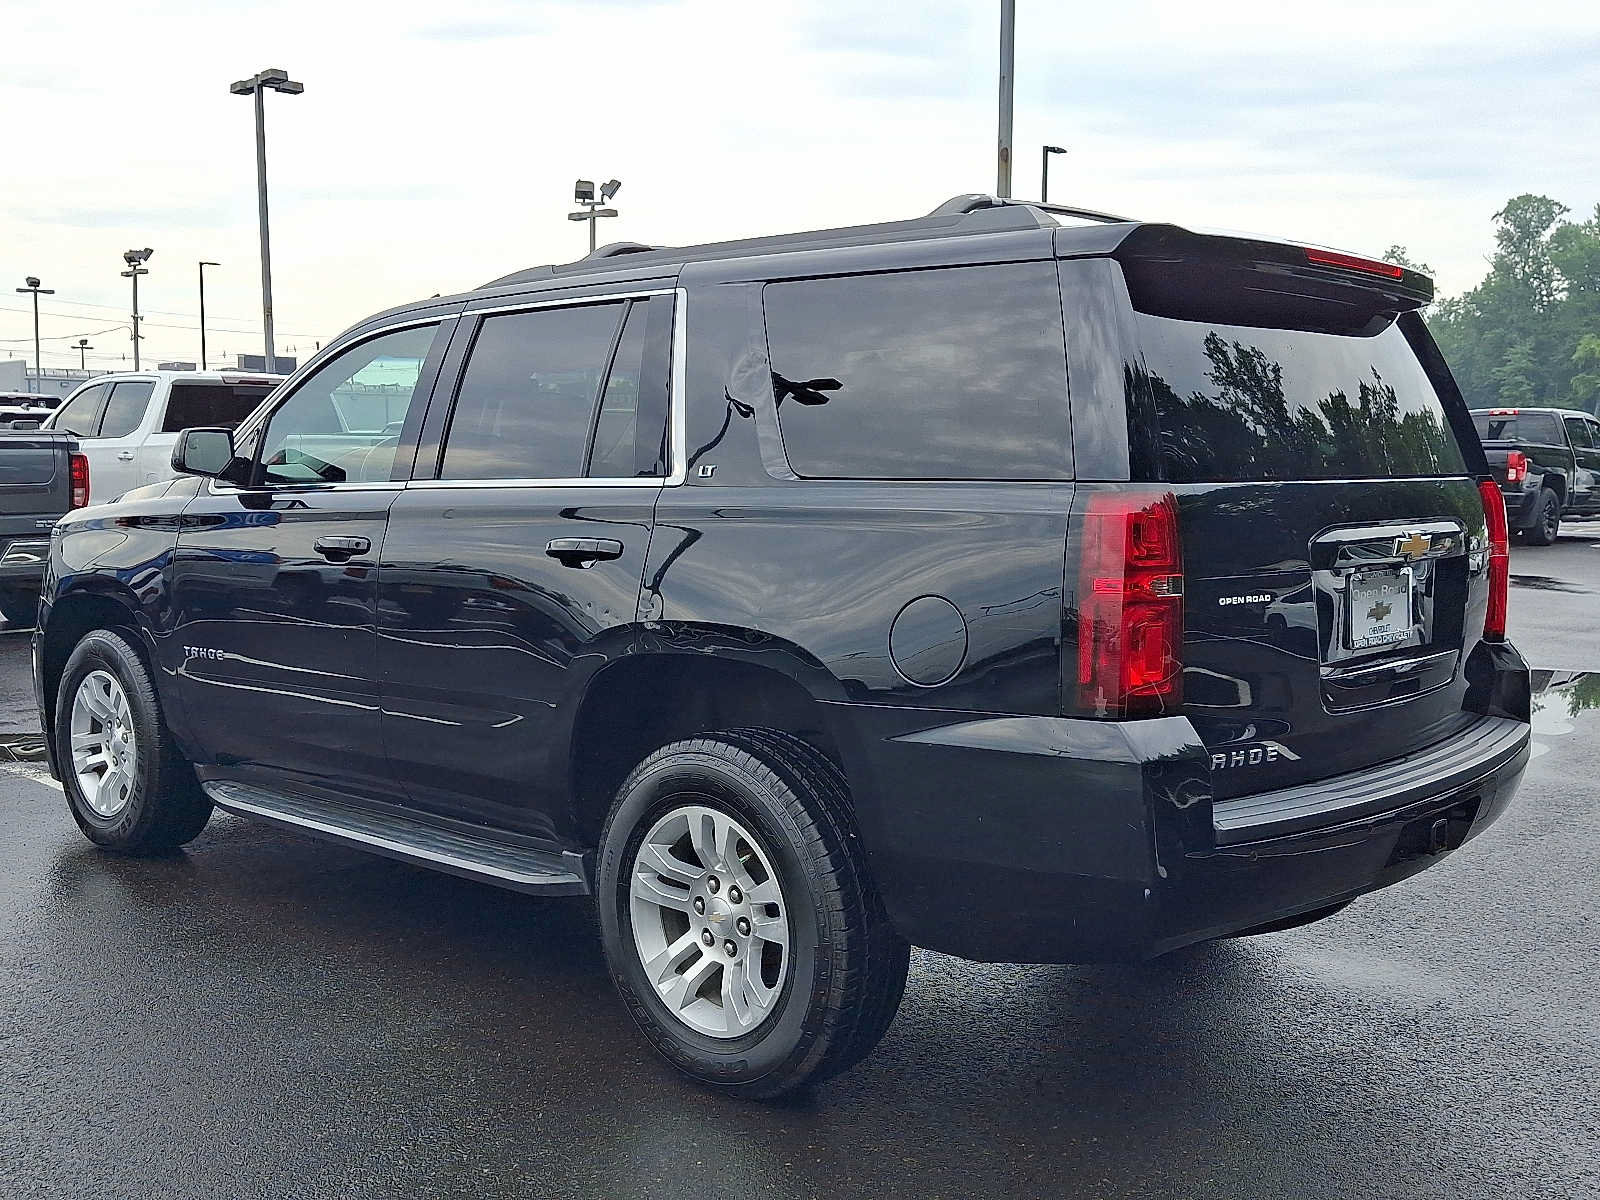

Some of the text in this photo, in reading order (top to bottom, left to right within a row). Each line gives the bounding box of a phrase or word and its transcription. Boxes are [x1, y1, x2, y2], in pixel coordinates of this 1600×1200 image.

[698, 465, 717, 477] LT
[1219, 595, 1271, 605] OPEN ROAD
[1352, 589, 1378, 601] Open
[183, 645, 224, 661] TAHOE
[1209, 745, 1279, 771] AHOE
